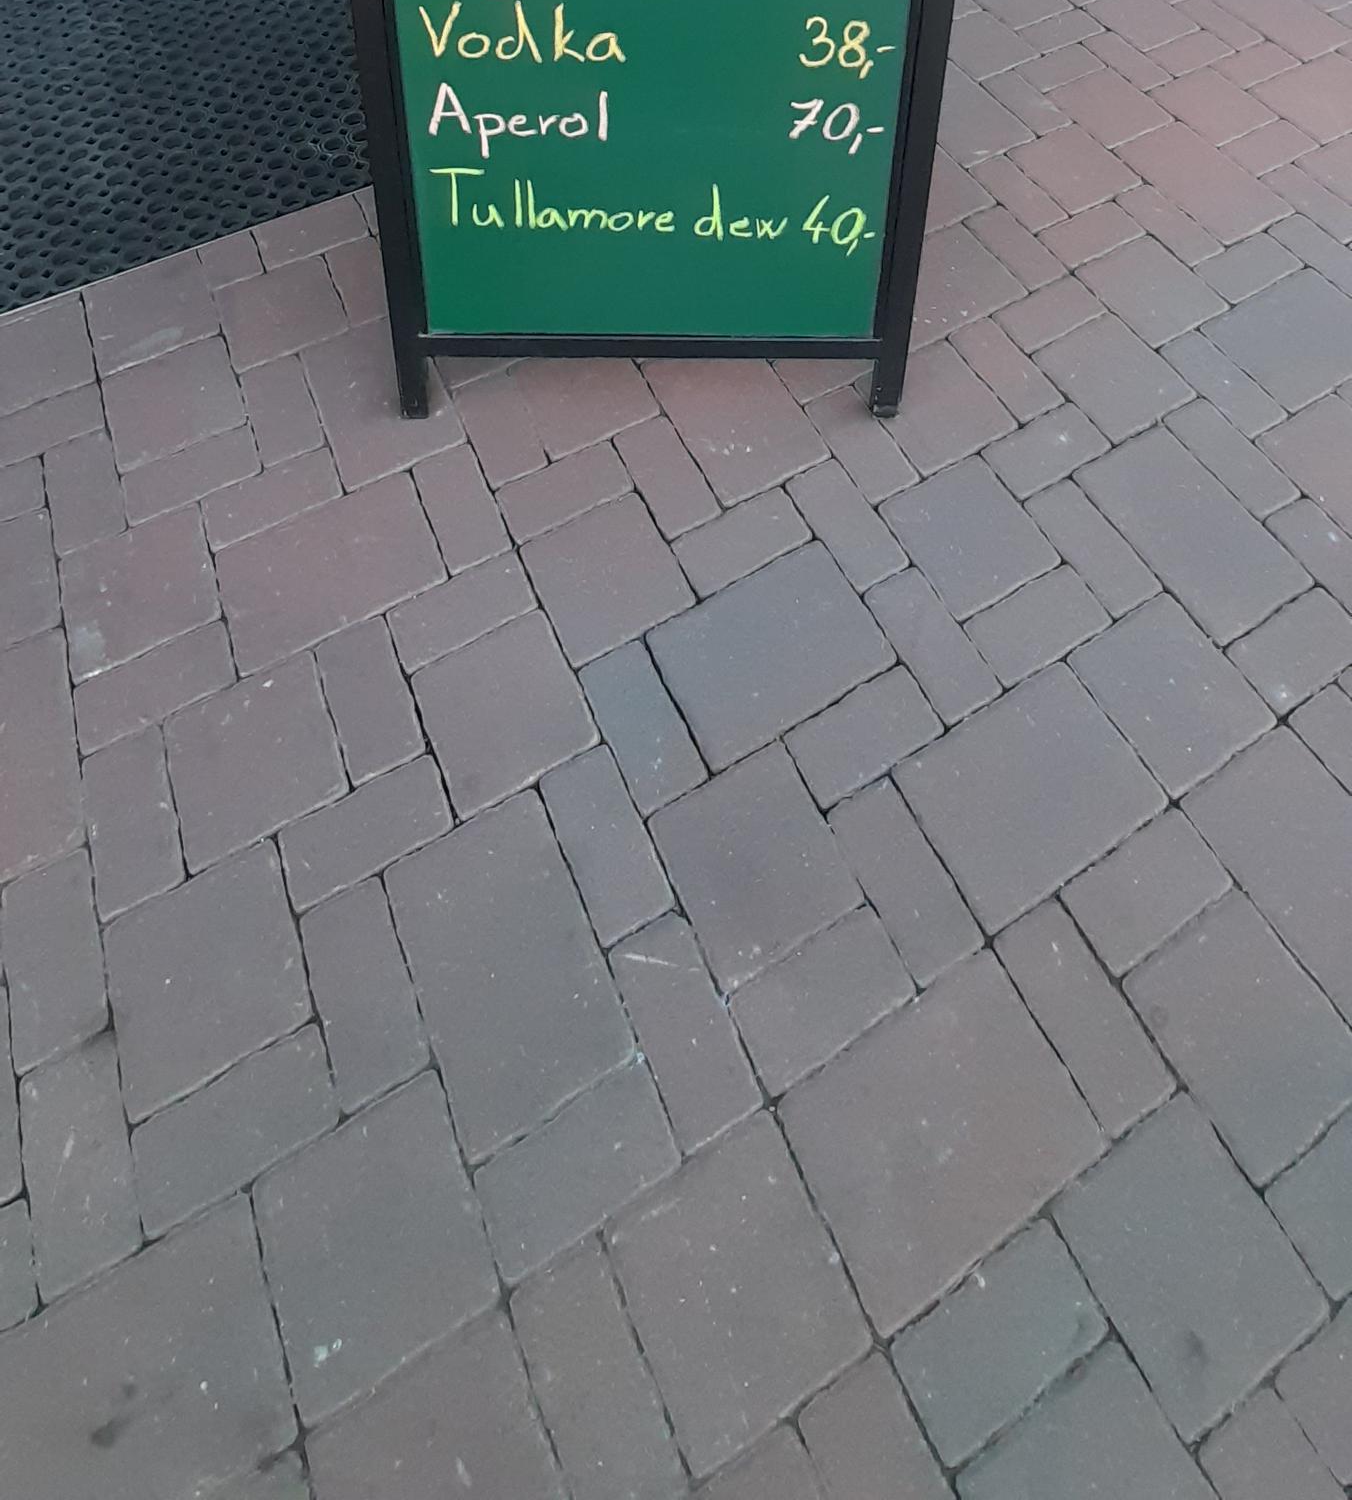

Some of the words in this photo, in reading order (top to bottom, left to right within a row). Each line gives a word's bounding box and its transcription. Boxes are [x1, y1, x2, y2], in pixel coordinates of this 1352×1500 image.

[419, 0, 626, 64] Vodka
[799, 17, 896, 79] 38,-
[427, 82, 609, 159] Aperol
[788, 98, 885, 155] 70,-
[428, 168, 675, 232] Tullamore
[693, 183, 788, 242] dew
[801, 195, 875, 257] 40,-
